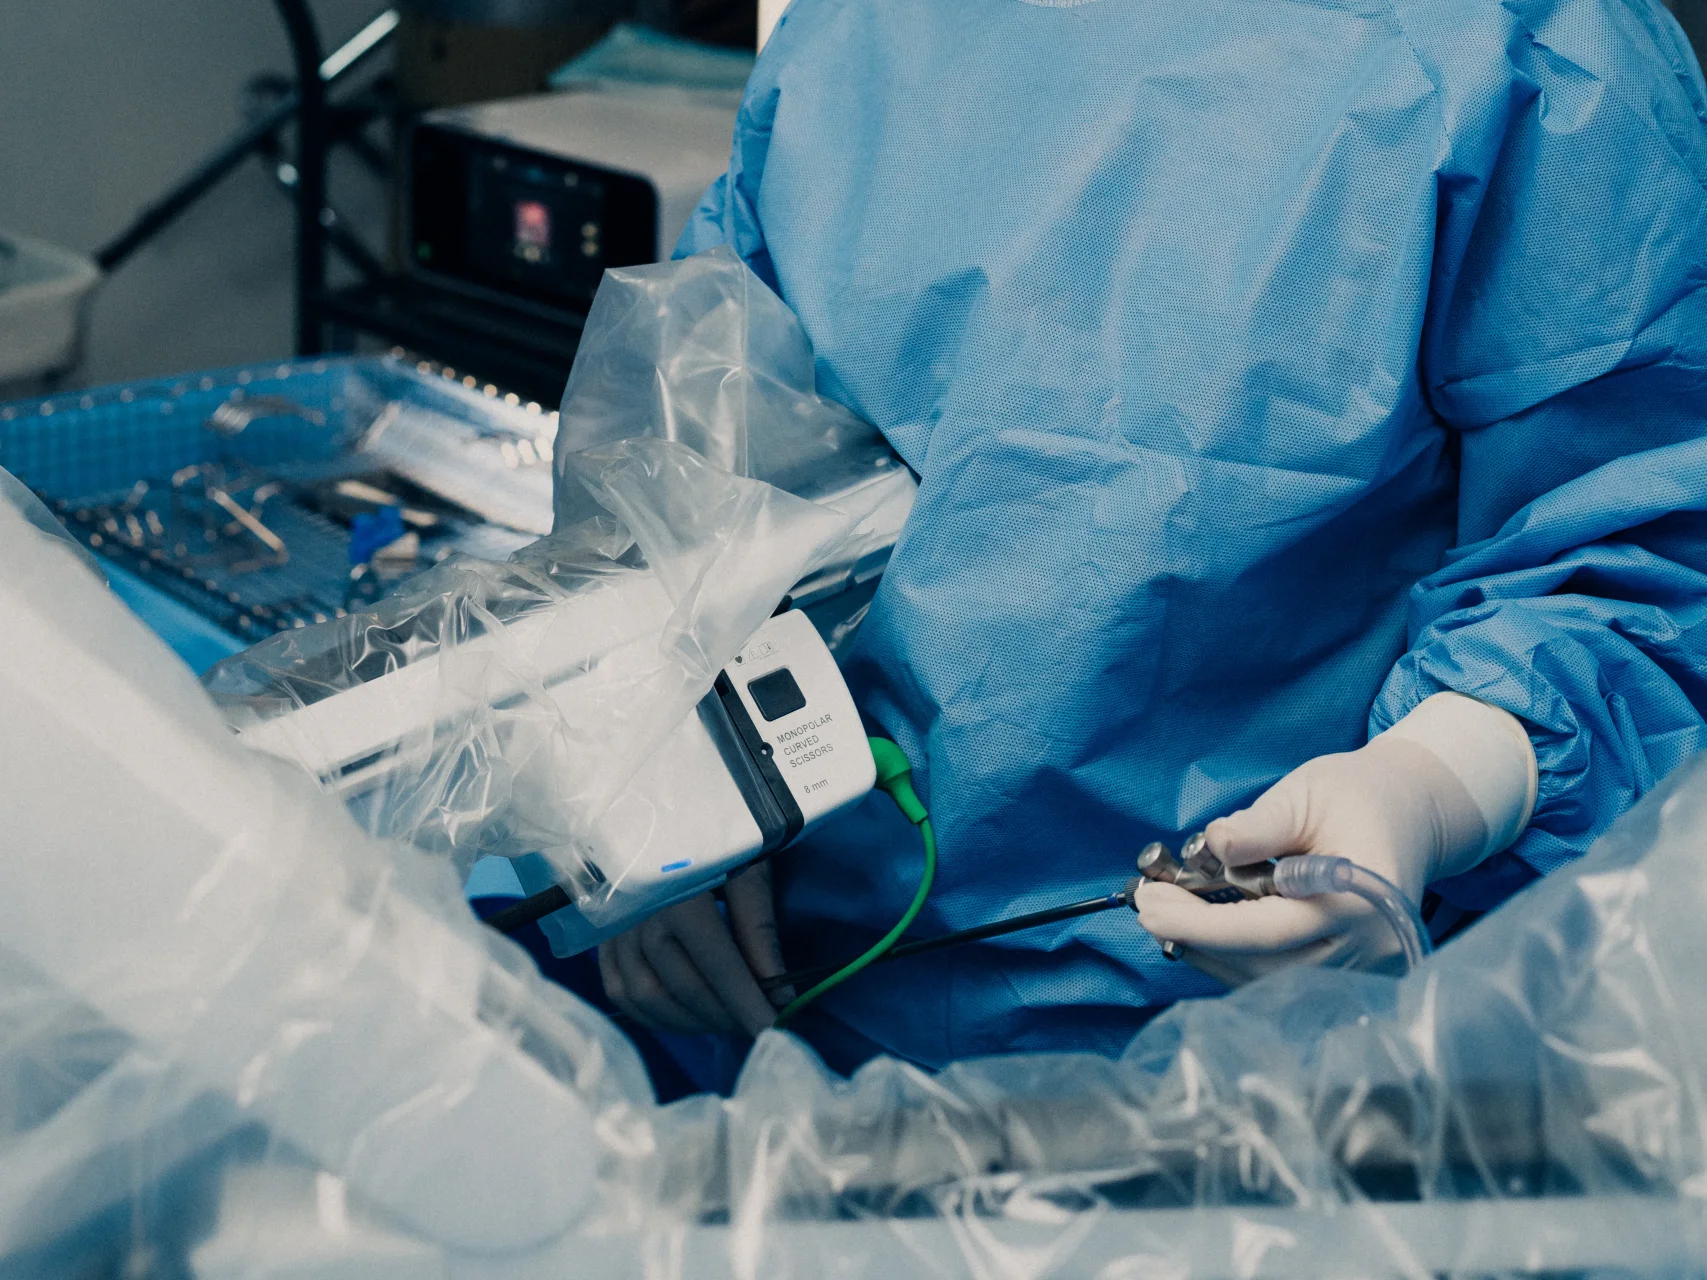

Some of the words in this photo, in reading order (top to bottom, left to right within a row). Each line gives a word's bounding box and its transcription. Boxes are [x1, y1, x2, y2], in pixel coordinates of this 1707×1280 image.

[776, 713, 833, 744] MONOPOLAR
[783, 734, 820, 756] CURVED
[789, 743, 835, 768] SCISSORS
[803, 785, 811, 794] 8
[812, 779, 829, 791] mm
